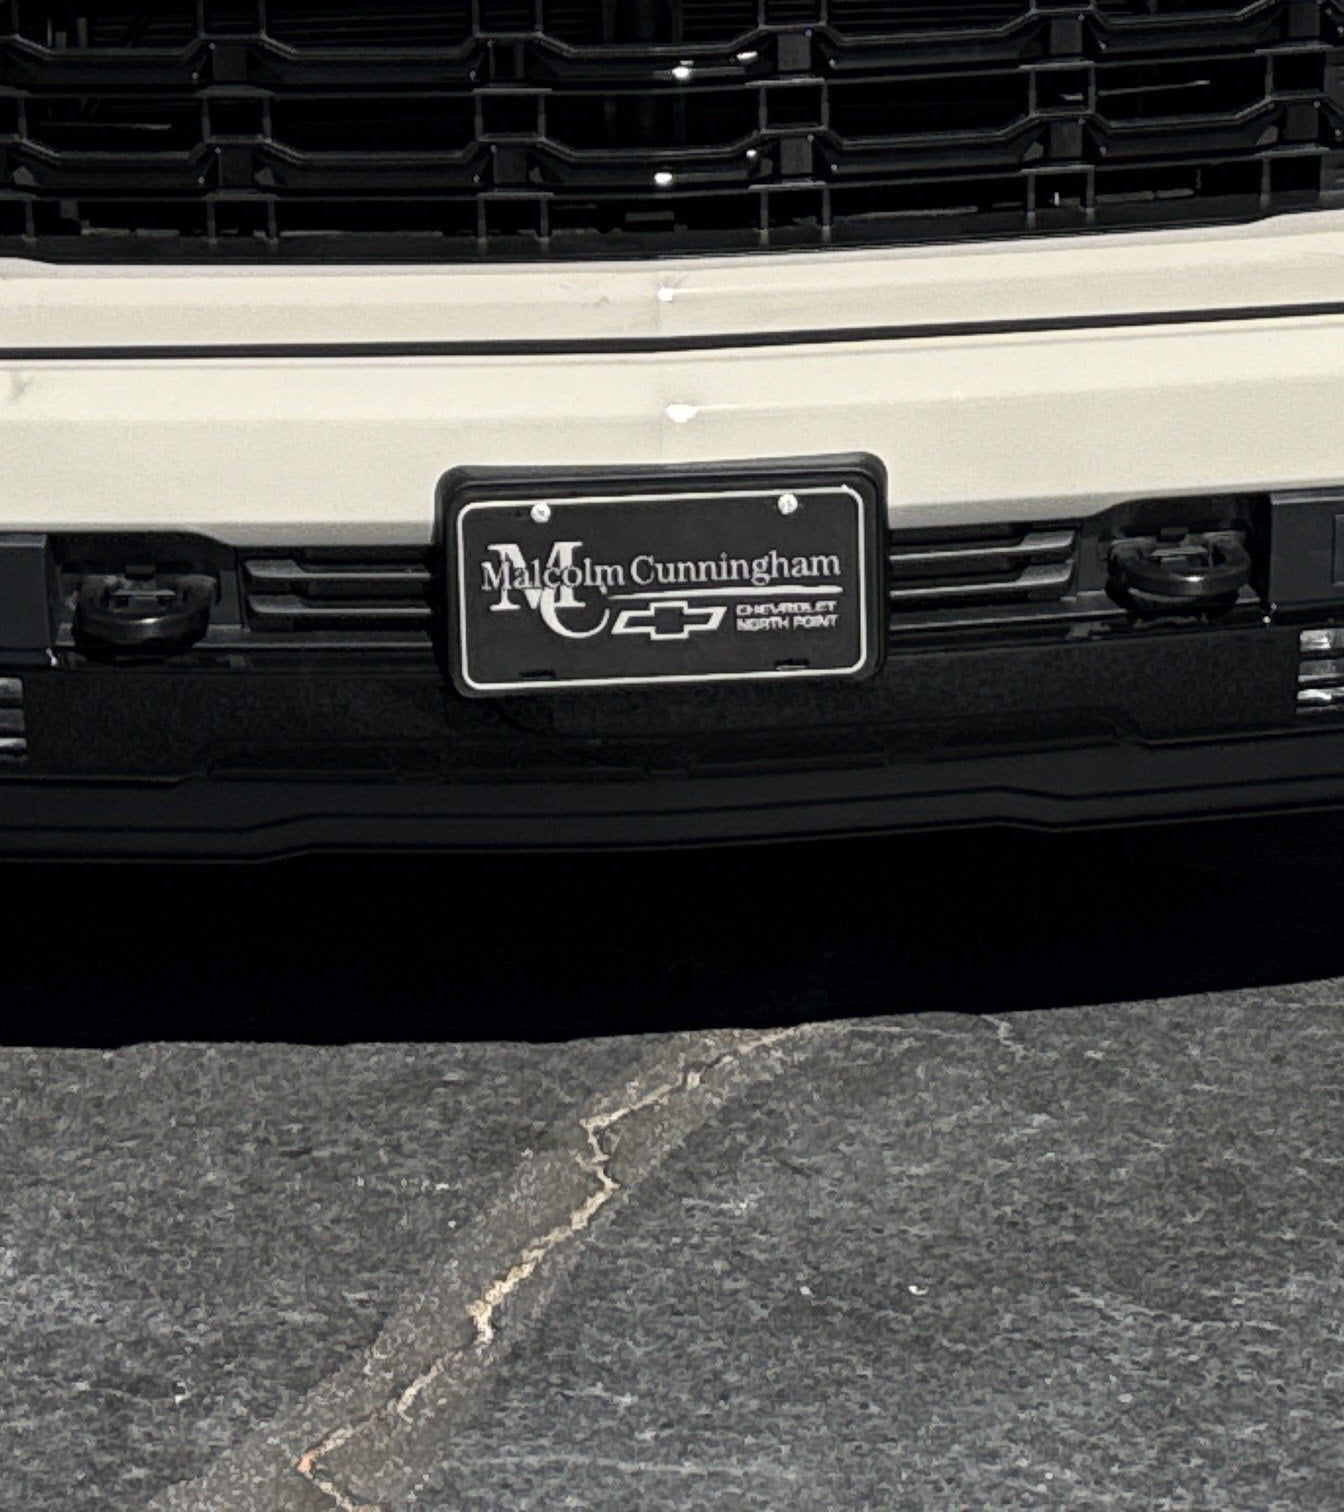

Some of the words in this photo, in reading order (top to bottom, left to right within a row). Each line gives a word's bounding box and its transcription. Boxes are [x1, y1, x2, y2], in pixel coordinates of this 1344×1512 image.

[481, 555, 626, 590] Malcolm
[630, 549, 842, 586] Cunningham
[736, 600, 838, 615] CHEVROLET
[736, 616, 789, 631] NORTH
[793, 614, 838, 629] POINT
